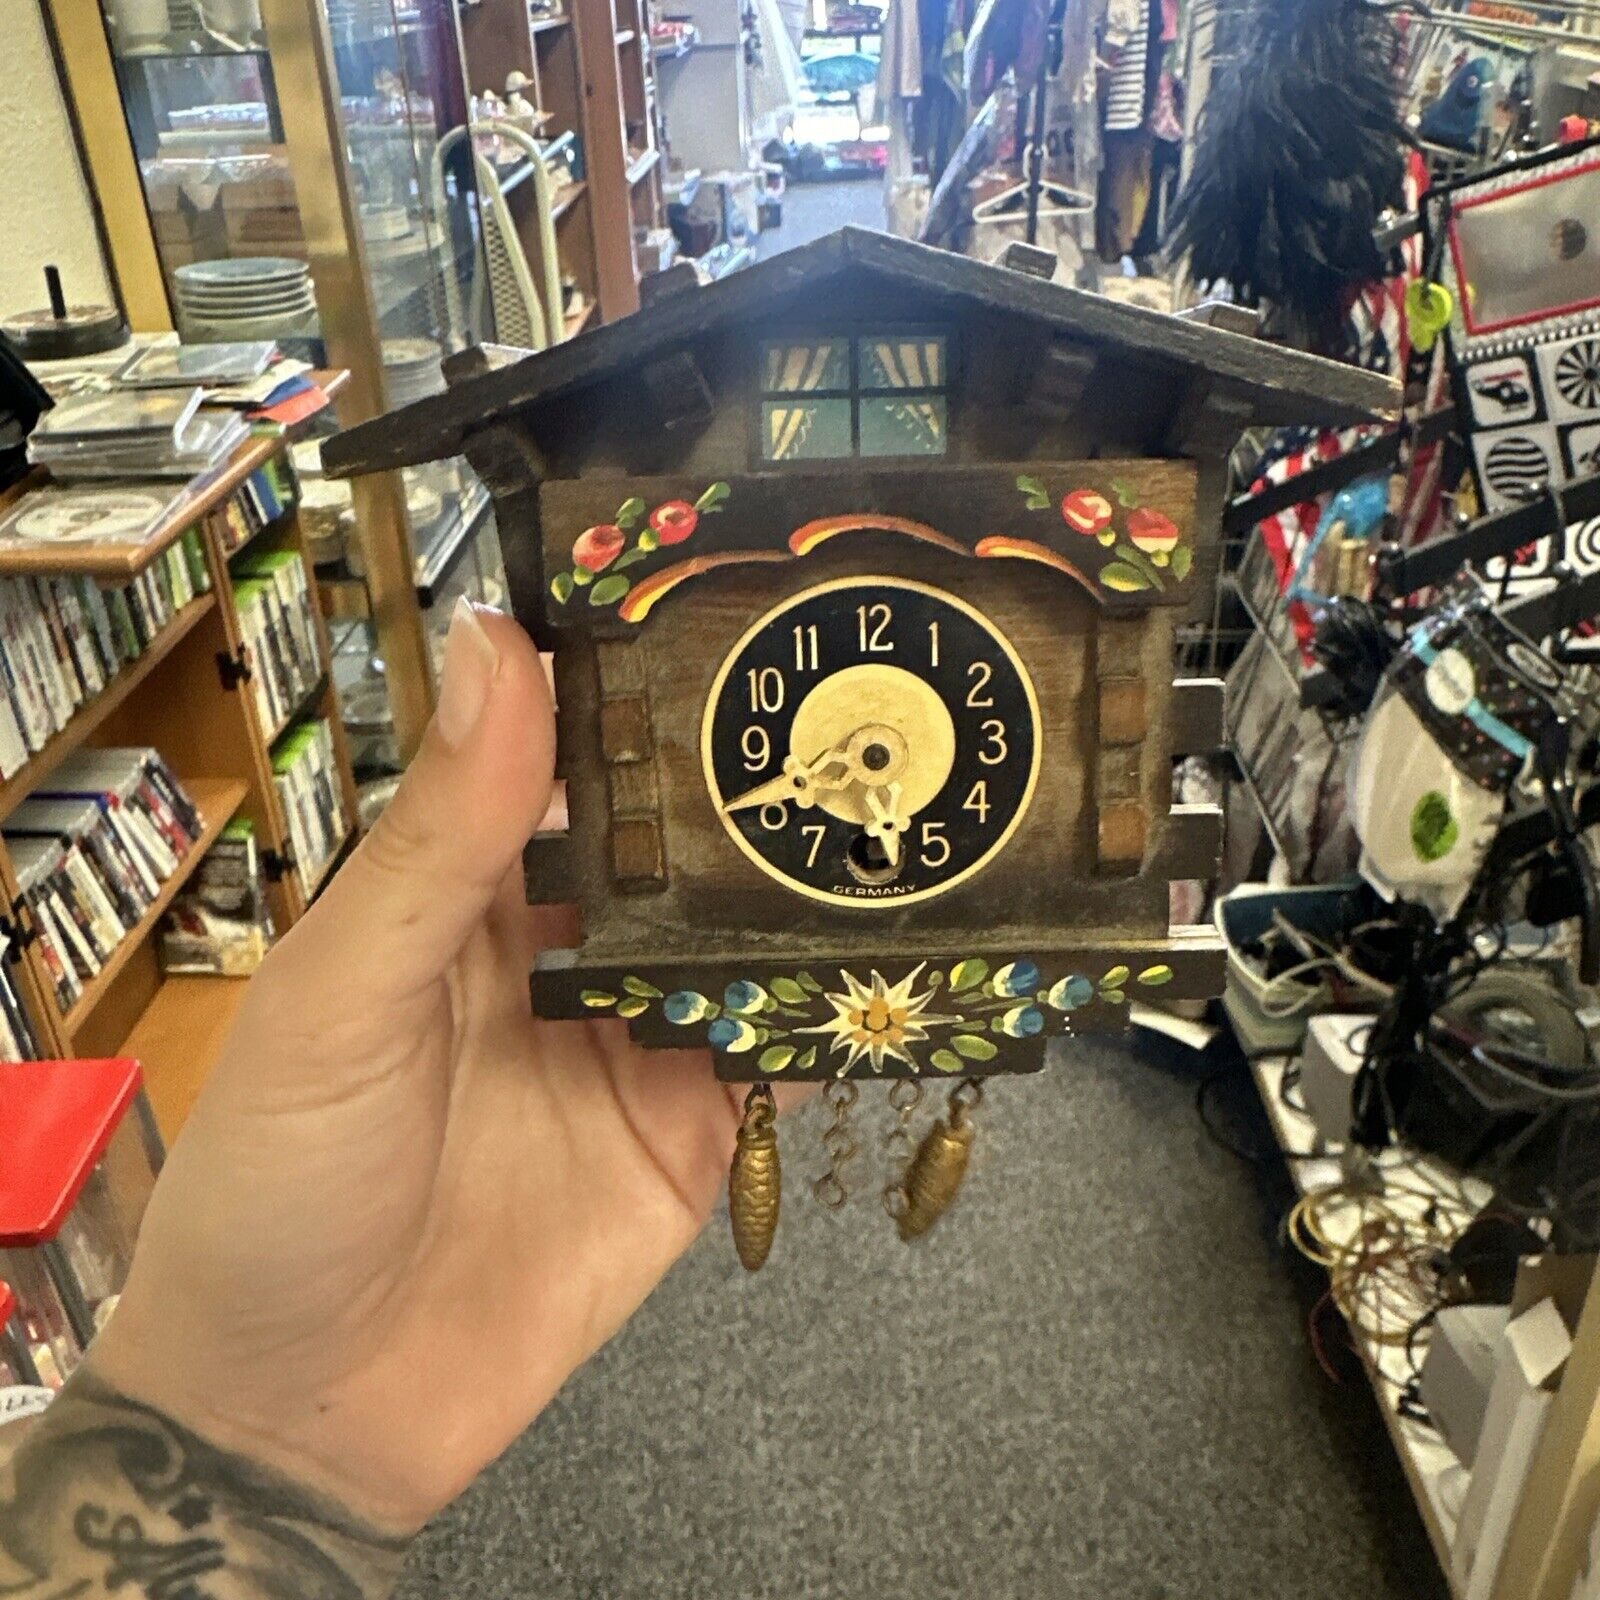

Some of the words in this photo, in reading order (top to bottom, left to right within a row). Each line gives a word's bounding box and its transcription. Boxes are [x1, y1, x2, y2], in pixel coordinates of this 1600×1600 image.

[793, 625, 819, 670] 11
[856, 604, 894, 651] 12
[928, 622, 939, 667] 1
[747, 667, 785, 713] 10
[966, 662, 994, 707] 2
[741, 726, 770, 771] 9
[978, 720, 1008, 765] 3
[962, 780, 991, 824] 4
[802, 825, 826, 867] 7
[920, 822, 951, 867] 5
[833, 884, 916, 896] GERMANY
